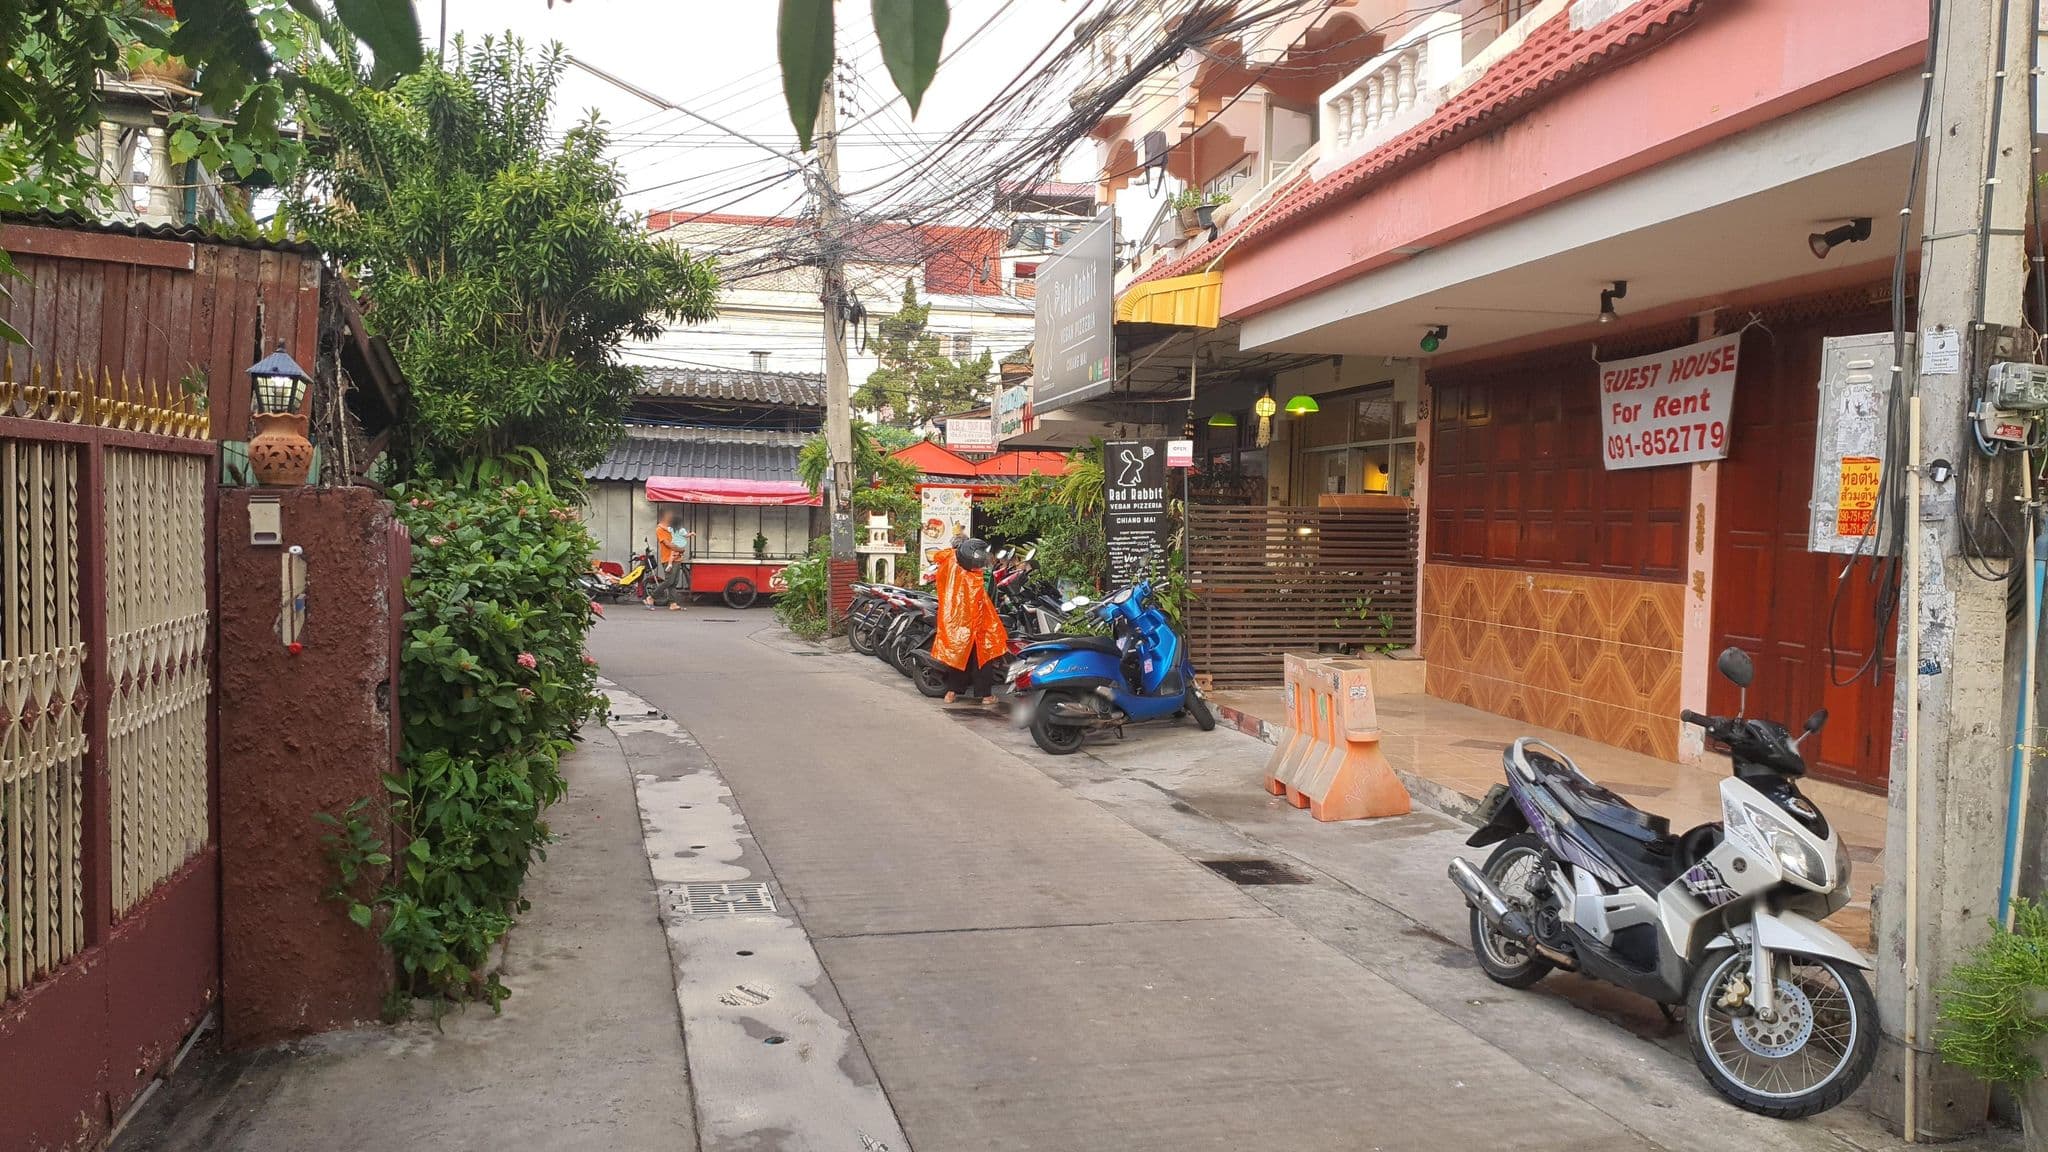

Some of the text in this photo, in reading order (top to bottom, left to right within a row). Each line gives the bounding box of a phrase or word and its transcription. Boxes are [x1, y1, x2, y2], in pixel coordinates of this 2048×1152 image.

[1604, 344, 1736, 393] GUEST HOUSE
[1612, 387, 1711, 424] For Rent
[1608, 421, 1724, 460] 091-852779
[1840, 465, 1879, 486] ท่อตัน
[1109, 487, 1163, 501] Rad Rabbit
[1133, 502, 1163, 510] PIZZERIA
